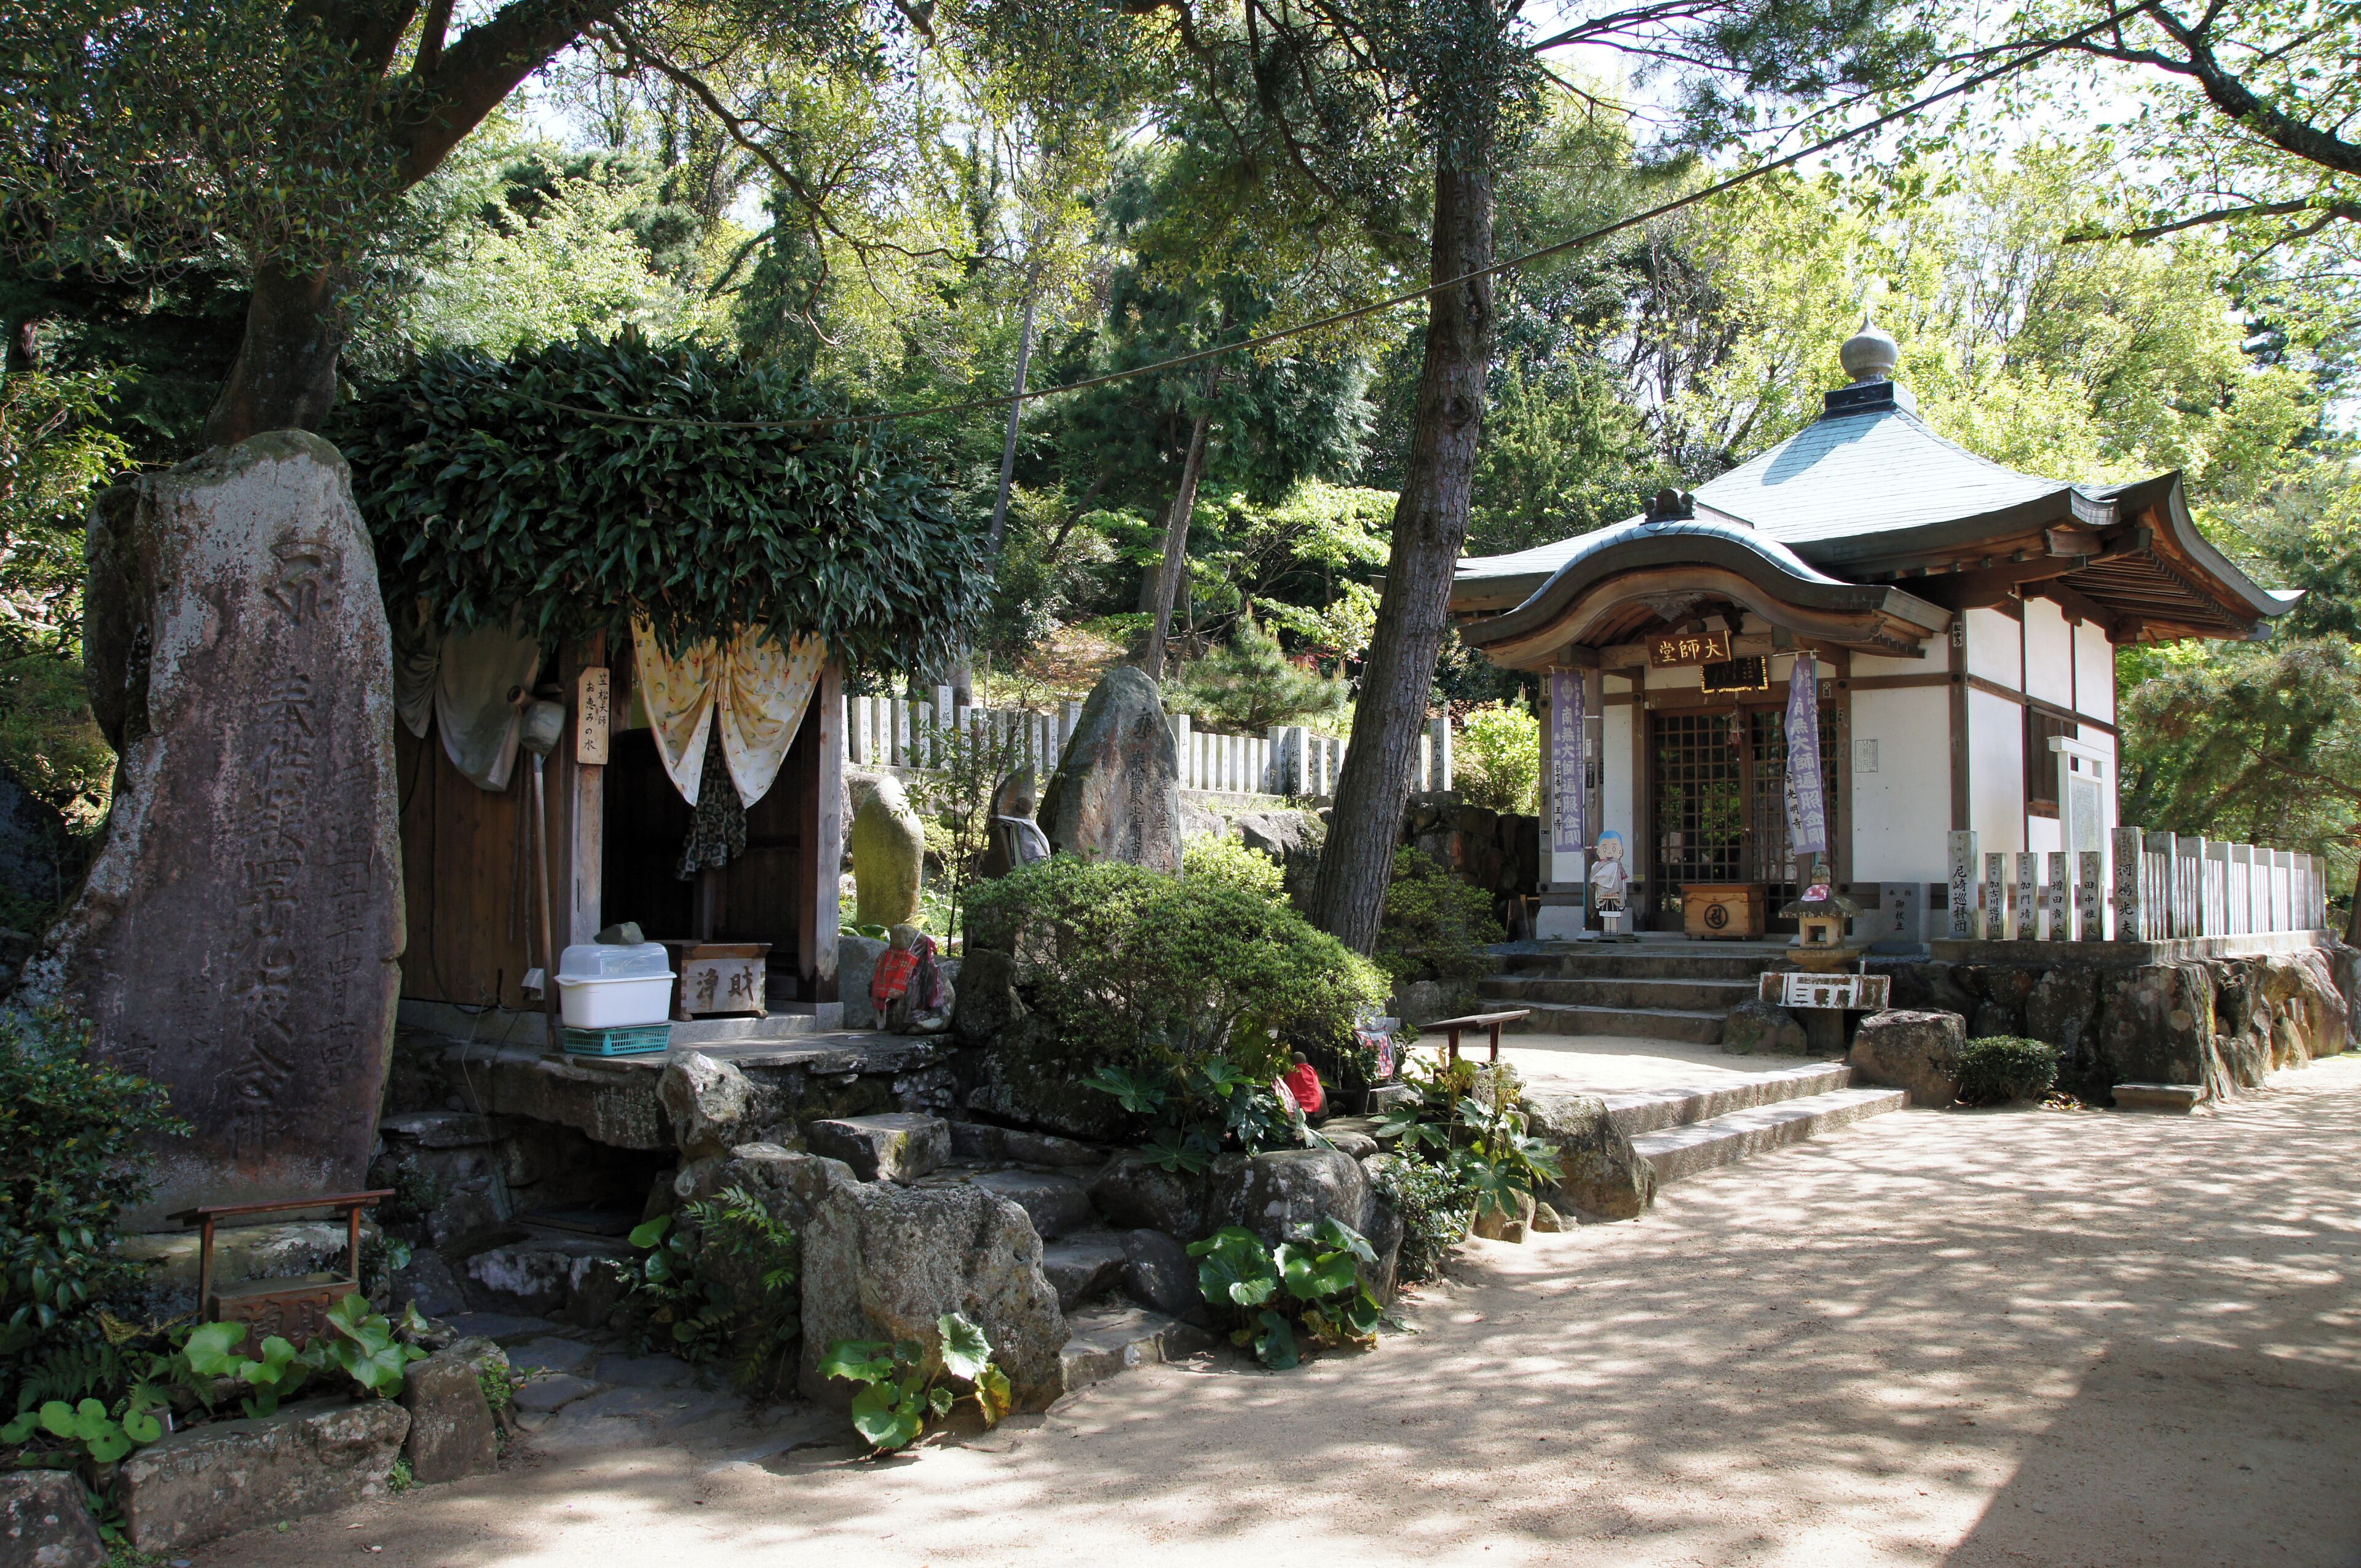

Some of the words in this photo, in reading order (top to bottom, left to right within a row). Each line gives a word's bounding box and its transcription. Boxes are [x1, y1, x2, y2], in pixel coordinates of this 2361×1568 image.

[1660, 639, 1724, 663] 大師堂
[583, 680, 597, 751] お恵みの水
[598, 672, 608, 728] 笠松大師
[1562, 706, 1581, 845] 南無大師遍照金剛
[1787, 789, 1802, 830] 光明寺
[1953, 865, 1968, 933] 尼崎巡拝団
[1988, 881, 1999, 931] 加古川巡拝団
[2020, 881, 2031, 933] 加門靖弘
[2052, 880, 2063, 933] 増田貴文
[2117, 863, 2134, 935] 河嶋光夫
